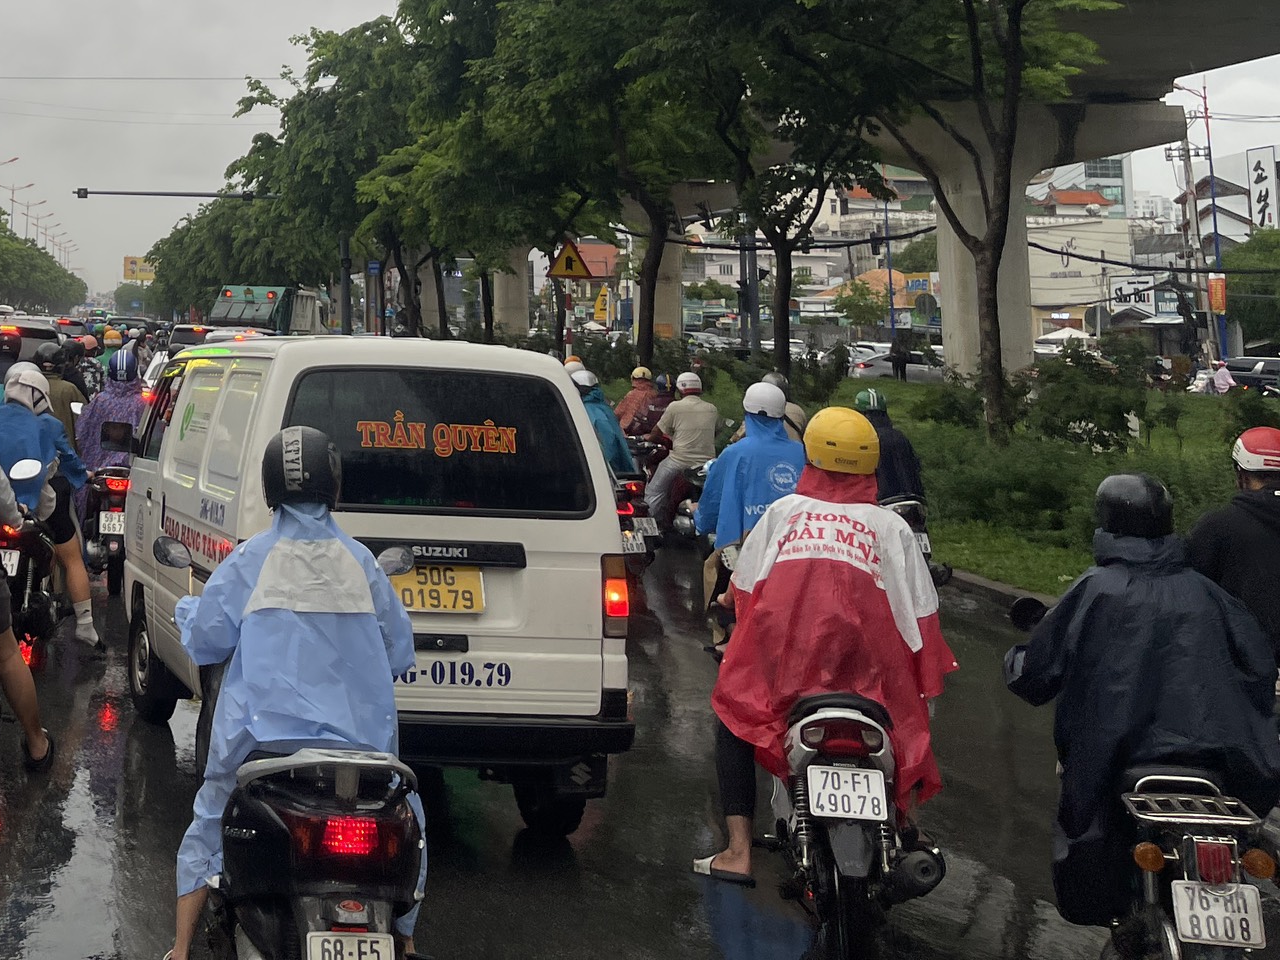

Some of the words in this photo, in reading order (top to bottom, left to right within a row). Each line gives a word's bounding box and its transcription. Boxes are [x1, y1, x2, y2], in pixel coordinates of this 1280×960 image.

[356, 409, 426, 449] TRẦN
[433, 419, 517, 458] QUYÊN
[102, 523, 123, 532] 966.7
[805, 511, 877, 543] HONDA
[412, 546, 468, 558] SUZUKI
[415, 566, 456, 586] 50G
[401, 588, 474, 609] 019.79
[393, 660, 512, 687] G-019.79
[820, 770, 871, 794] 70-F1
[815, 792, 882, 816] 490.78
[1189, 914, 1251, 942] 8008
